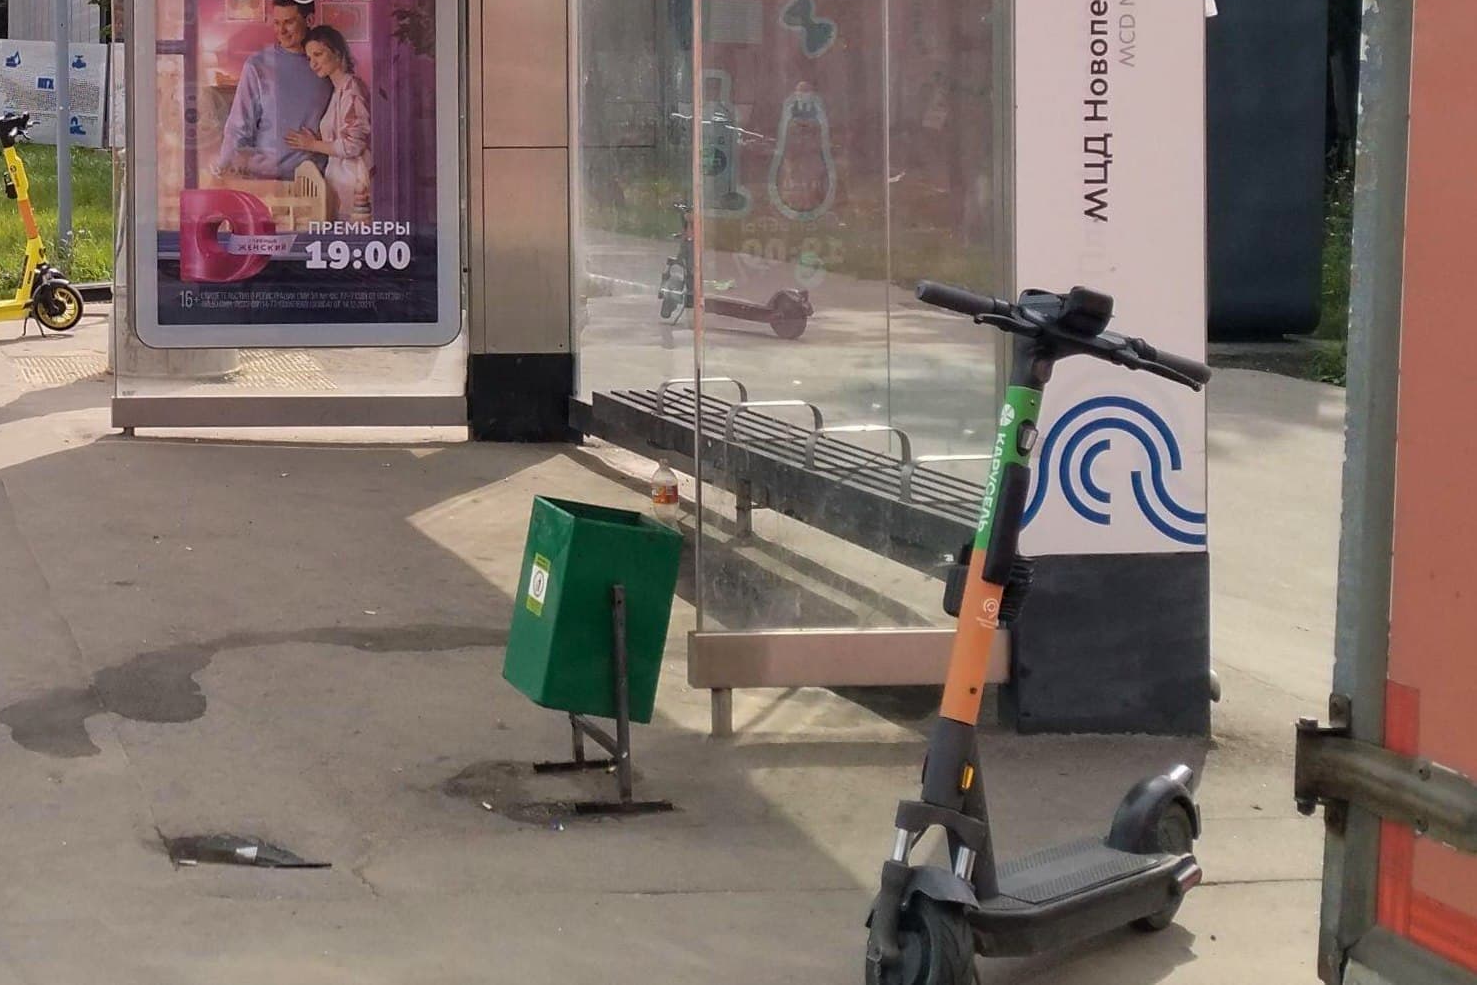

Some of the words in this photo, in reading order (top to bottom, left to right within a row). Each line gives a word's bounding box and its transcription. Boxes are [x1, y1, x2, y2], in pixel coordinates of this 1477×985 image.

[1118, 14, 1137, 68] MCD
[1083, 133, 1113, 223] МЦД
[308, 221, 411, 236] ПРЕМЬЕРЫ
[305, 240, 412, 270] 19:00
[179, 290, 201, 309] 16+
